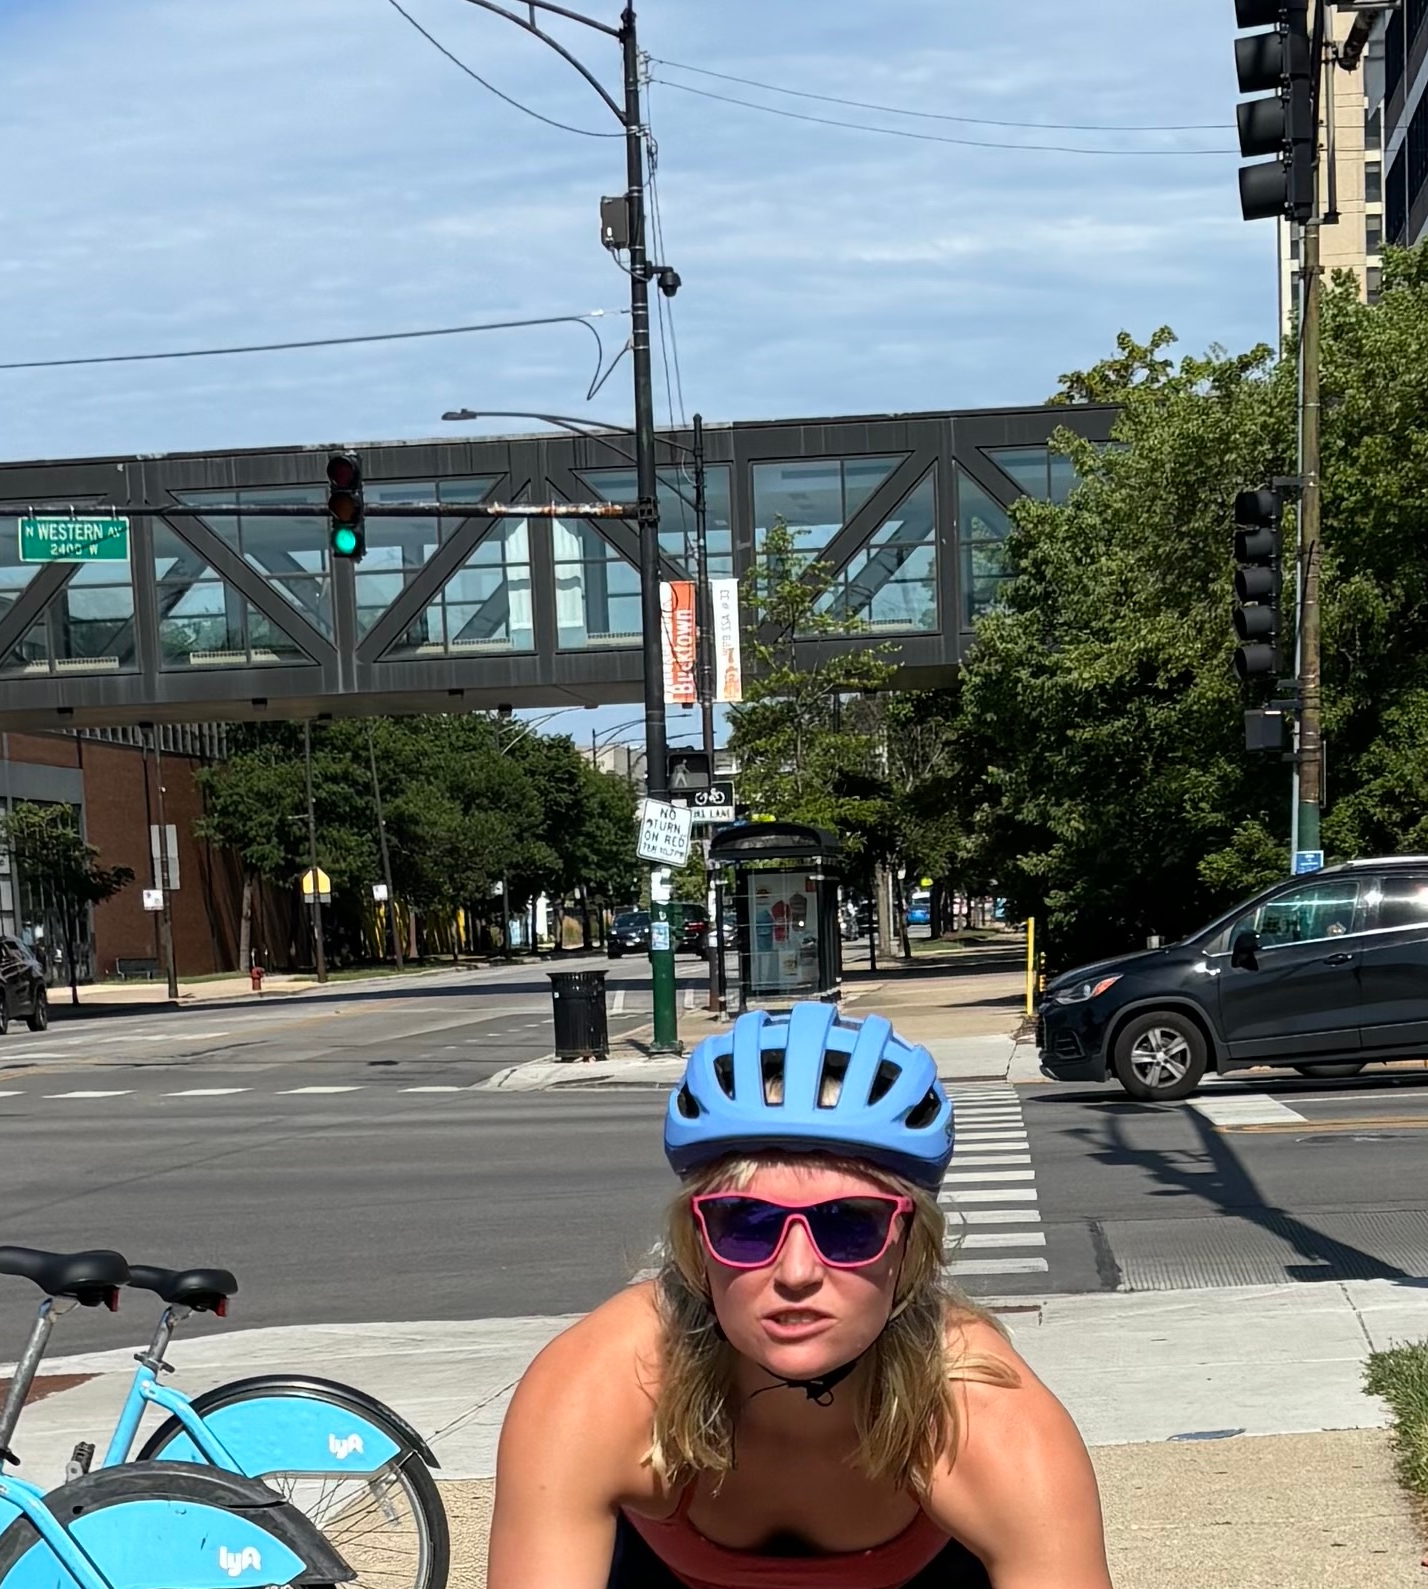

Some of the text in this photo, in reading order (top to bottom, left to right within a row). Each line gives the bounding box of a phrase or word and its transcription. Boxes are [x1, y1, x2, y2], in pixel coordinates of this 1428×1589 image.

[25, 526, 34, 537] N
[37, 523, 103, 541] WESTERN
[50, 543, 99, 555] 2400 W
[673, 609, 694, 694] Bucktown
[660, 808, 677, 821] NO
[653, 819, 681, 835] TURN
[645, 830, 685, 848] ON RED
[328, 1433, 364, 1460] lyft
[219, 1545, 262, 1577] lyft
